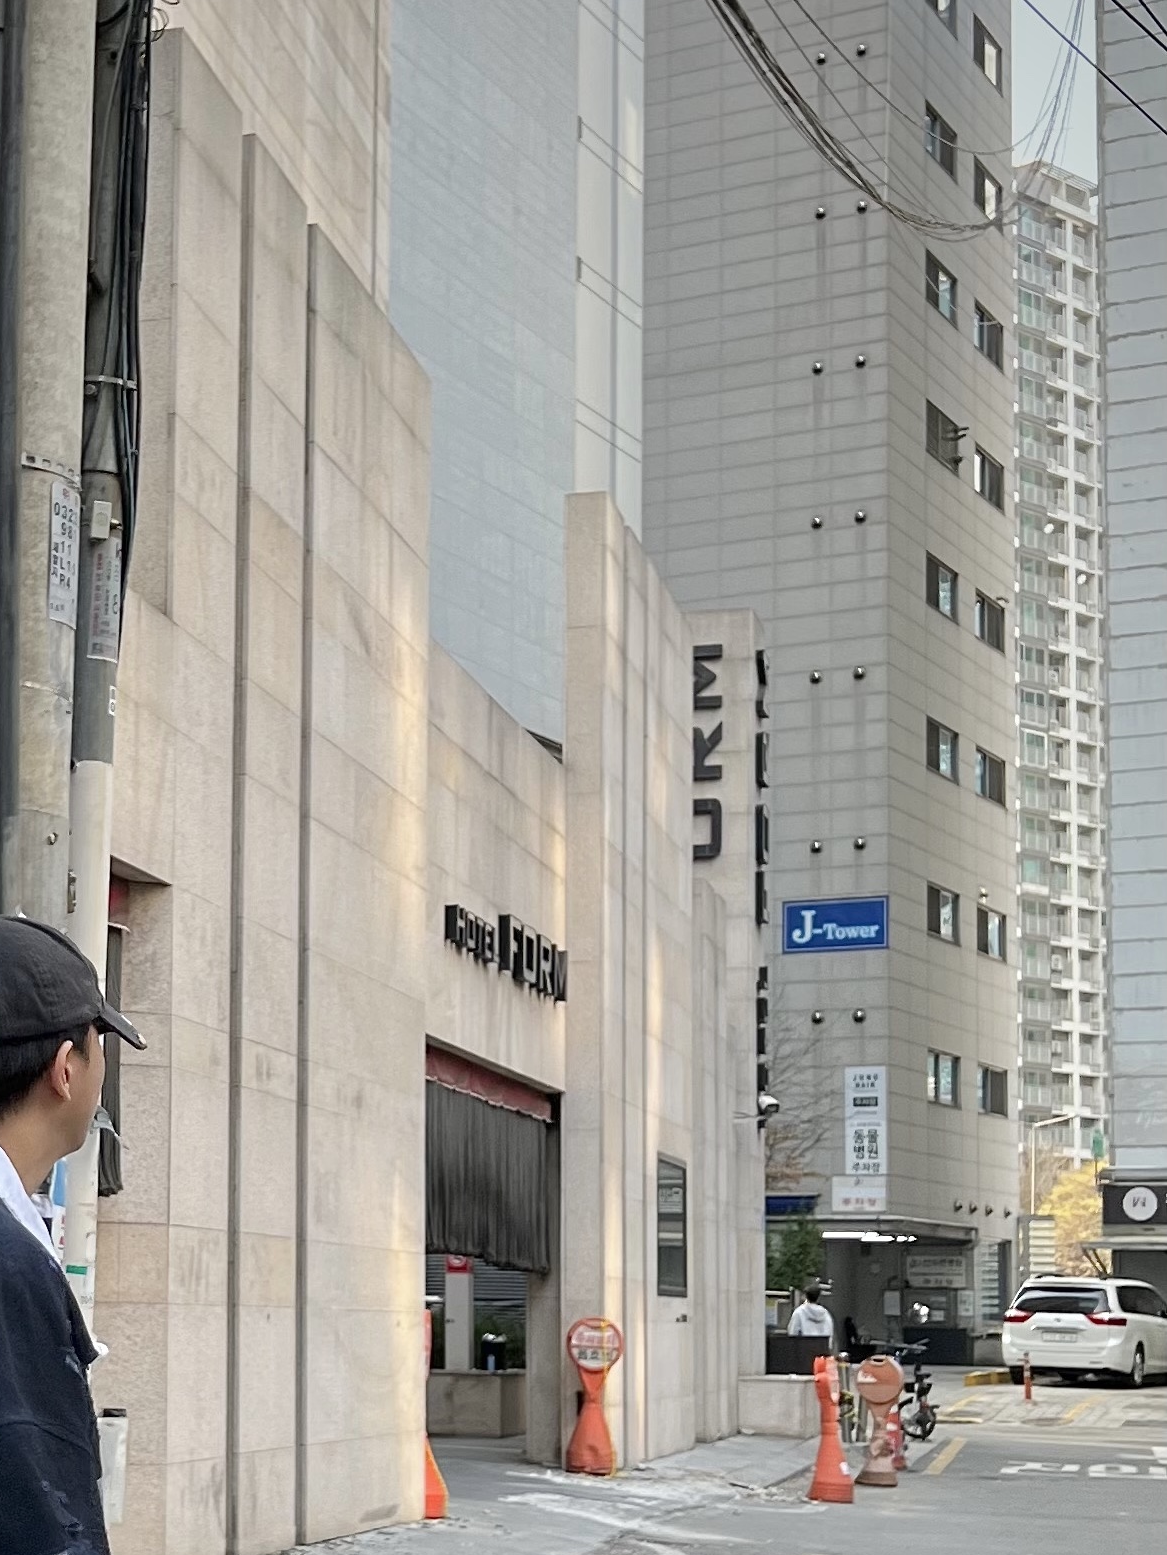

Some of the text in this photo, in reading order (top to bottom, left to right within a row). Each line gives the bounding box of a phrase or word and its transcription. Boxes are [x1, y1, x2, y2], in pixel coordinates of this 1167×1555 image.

[445, 904, 567, 1001] HOTEL FORM
[792, 910, 880, 943] J-Tower
